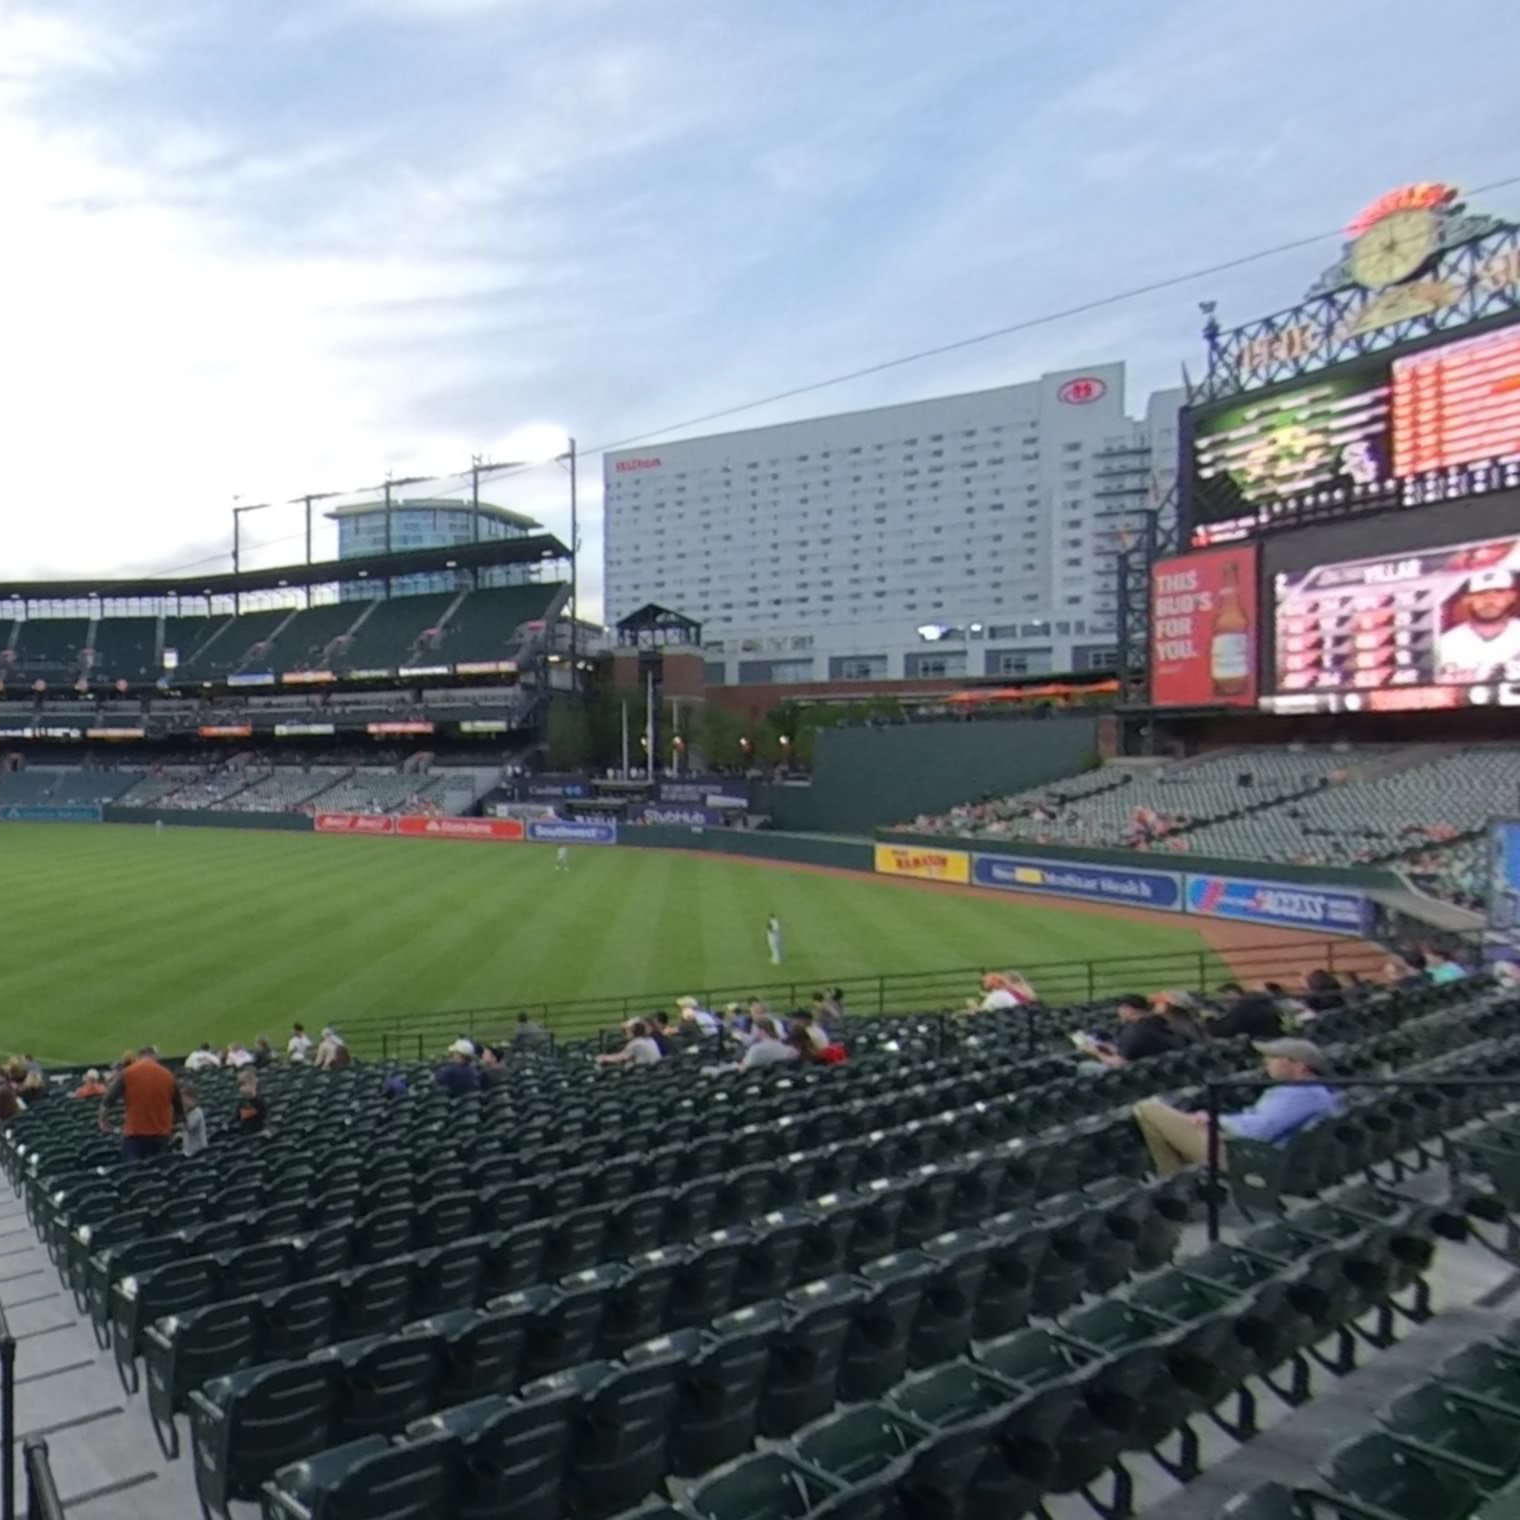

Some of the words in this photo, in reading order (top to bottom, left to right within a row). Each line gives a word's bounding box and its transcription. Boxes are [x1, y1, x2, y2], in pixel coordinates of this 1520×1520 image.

[1154, 569, 1198, 594] THIS
[1154, 591, 1213, 618] BUD'S
[1154, 617, 1192, 639] FOR
[1155, 639, 1198, 662] YOU.
[643, 809, 705, 825] StubHub
[533, 825, 597, 839] Southwest
